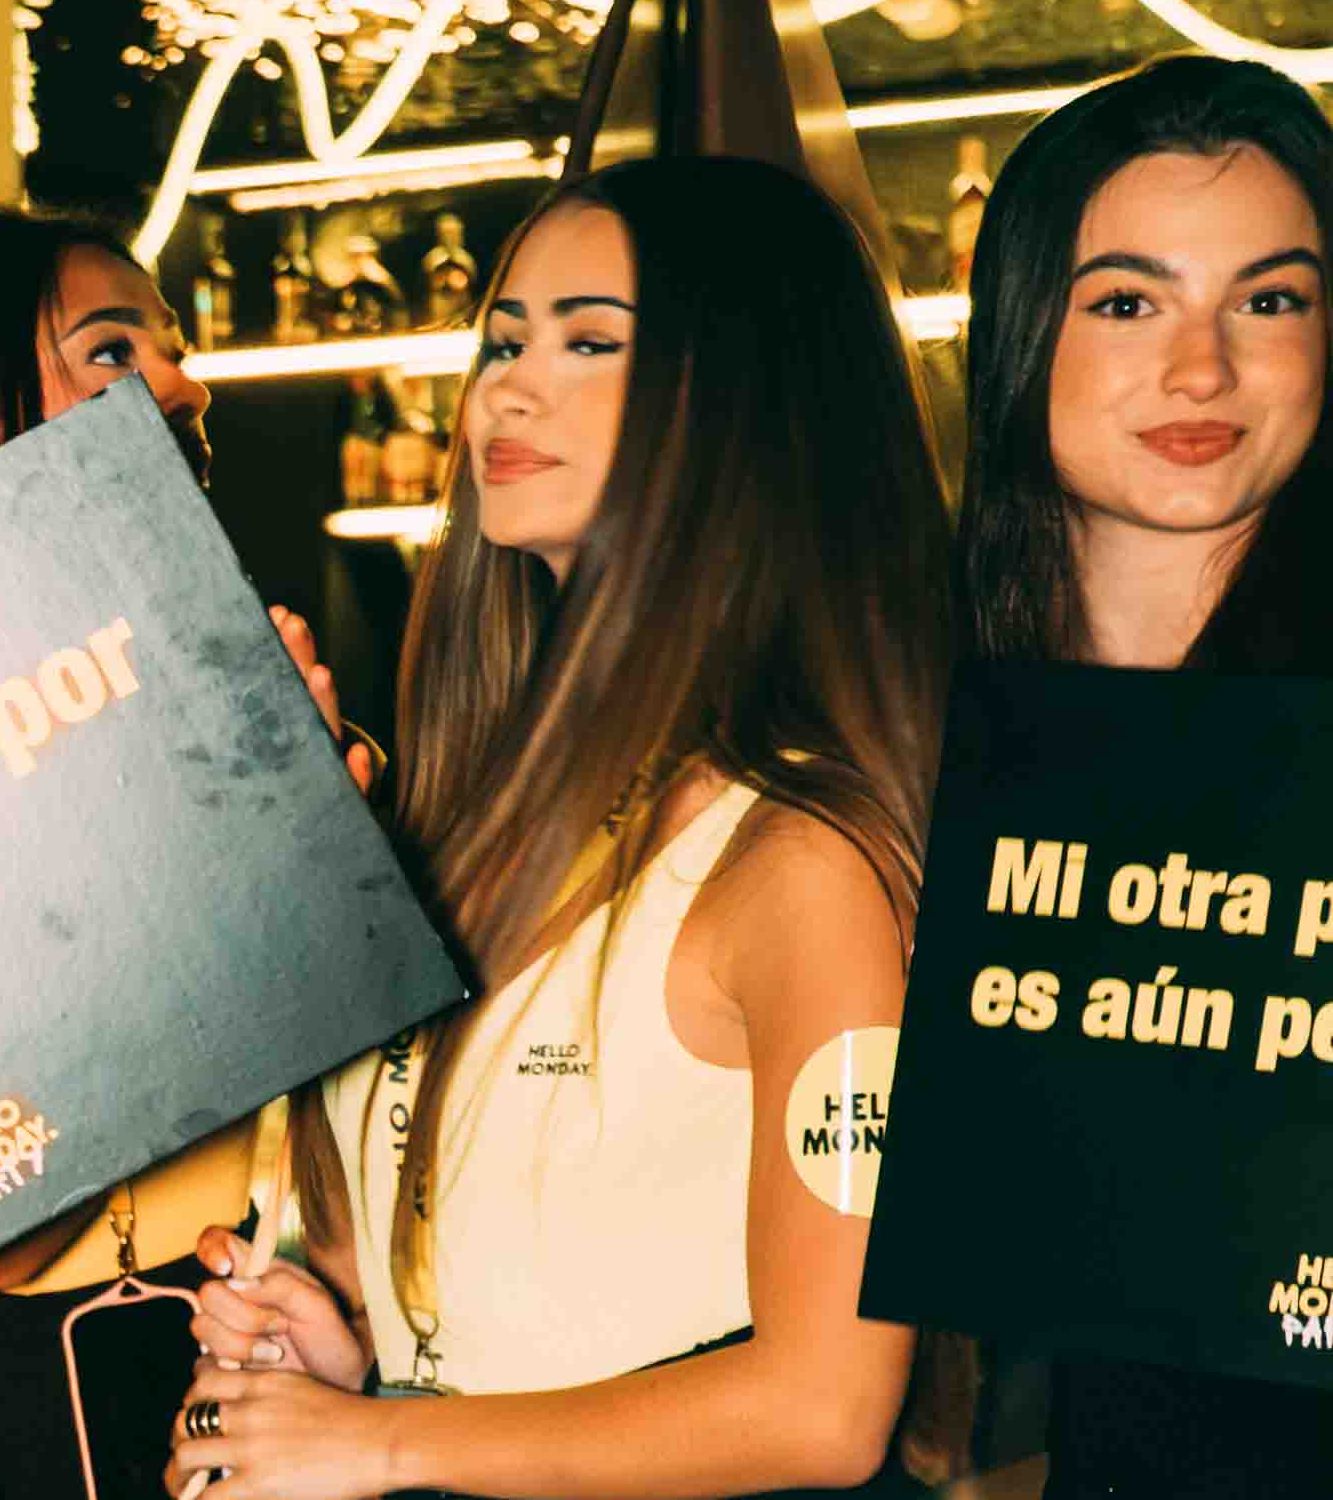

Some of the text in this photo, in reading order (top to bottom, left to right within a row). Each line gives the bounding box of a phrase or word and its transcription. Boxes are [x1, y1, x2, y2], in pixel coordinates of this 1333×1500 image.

[986, 836, 1089, 920] Mi
[1108, 852, 1272, 937] otra
[970, 965, 1061, 1032] es
[1081, 964, 1235, 1051] aún
[528, 1044, 581, 1059] HELLO
